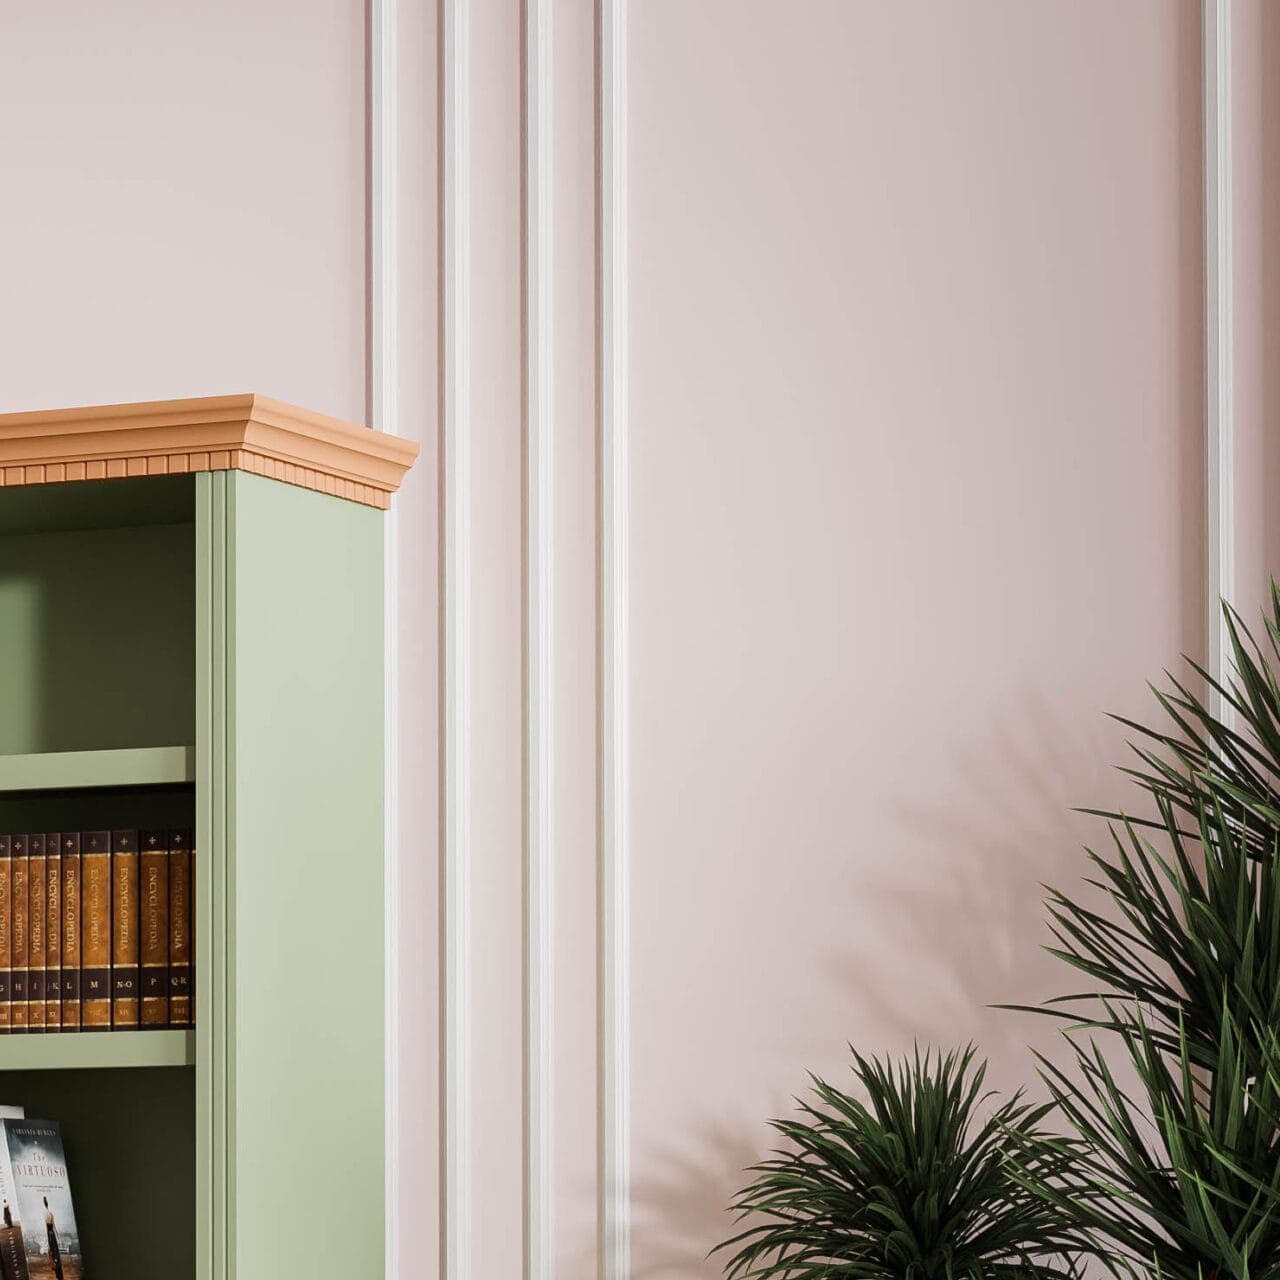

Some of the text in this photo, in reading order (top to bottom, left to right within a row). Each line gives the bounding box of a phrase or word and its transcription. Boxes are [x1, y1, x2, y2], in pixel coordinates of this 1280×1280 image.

[15, 871, 23, 953] ENCOPEDIA
[48, 870, 57, 952] ENCYCLOEDIA
[66, 870, 75, 952] ENCYCLOPEDIA
[120, 867, 128, 951] ENCYCLOPEDIA
[149, 867, 158, 950] ENCYCLOPEDIA
[66, 982, 72, 990] L
[17, 1164, 66, 1176] VIRTUOSO
